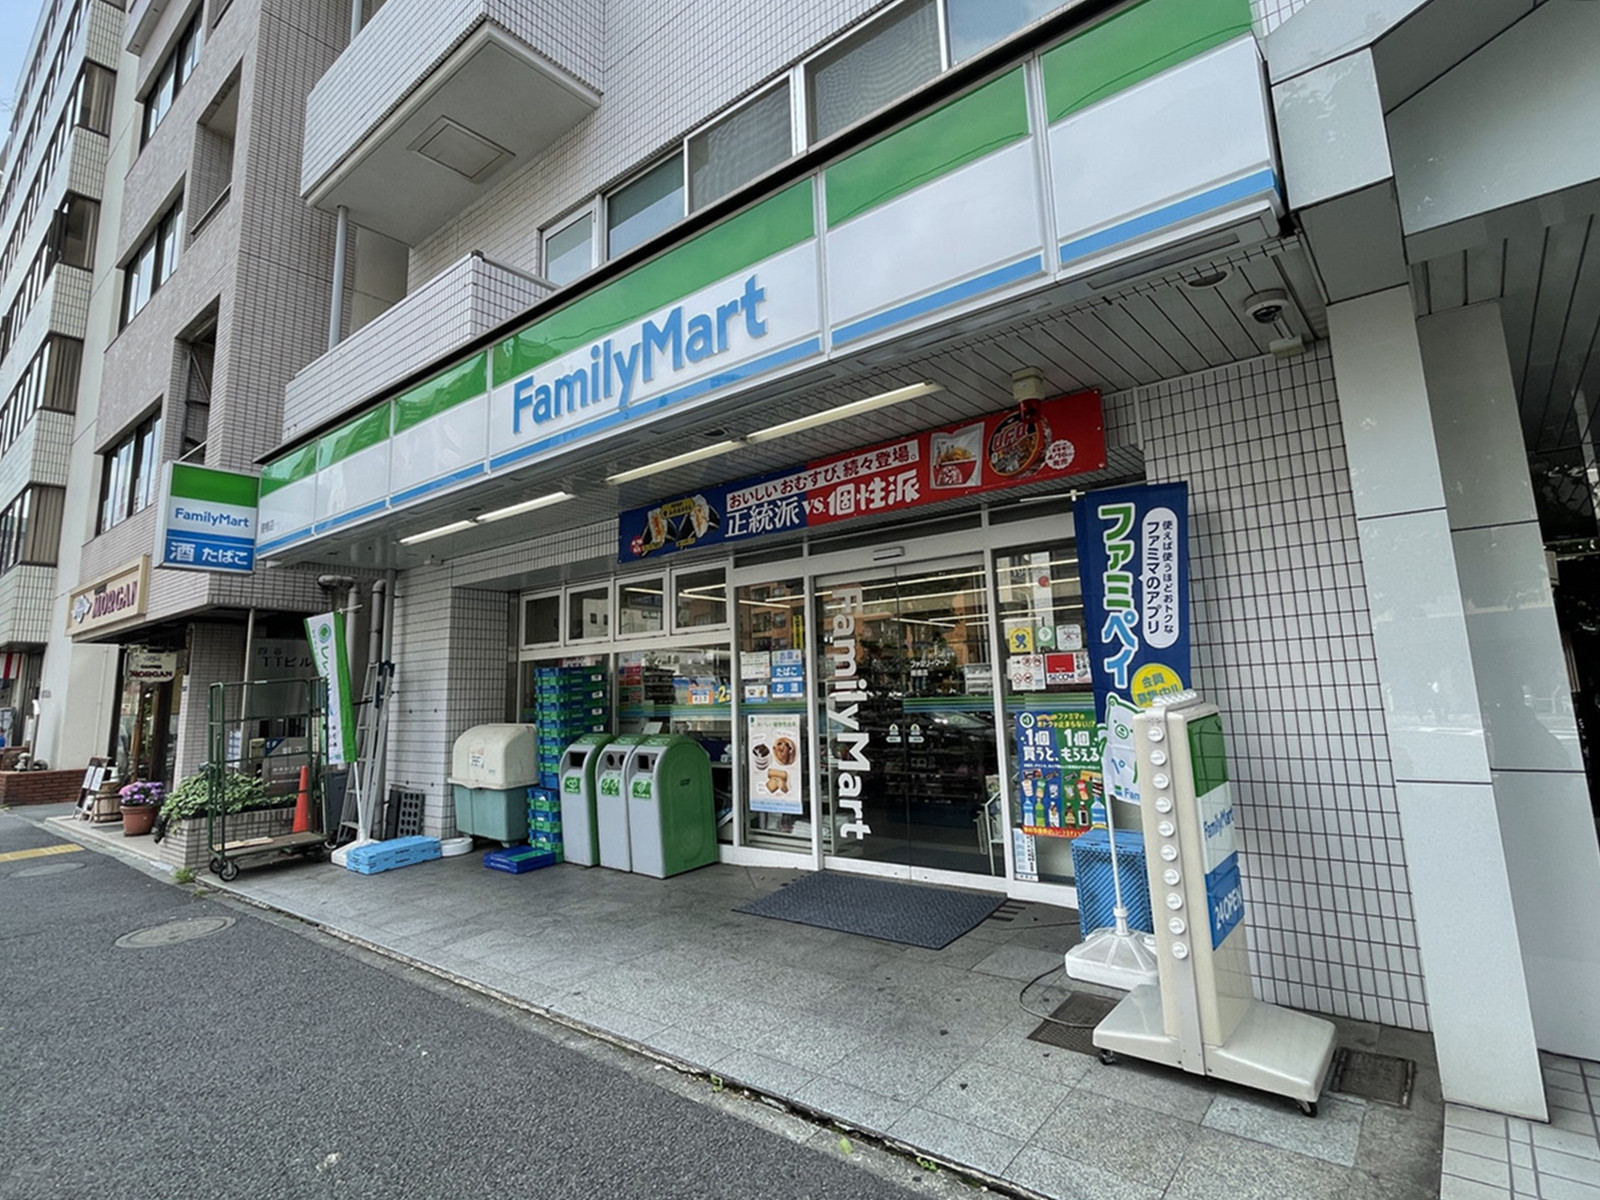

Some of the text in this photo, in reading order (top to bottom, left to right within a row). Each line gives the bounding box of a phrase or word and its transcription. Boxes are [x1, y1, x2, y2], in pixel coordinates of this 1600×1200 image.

[512, 274, 768, 435] FamilyMart
[724, 496, 801, 538] 正統派
[827, 469, 920, 516] 個性派
[174, 507, 250, 528] FamilyMart
[169, 542, 249, 566] 酒 たばこ
[1147, 521, 1162, 634] ファミマのアプリ
[1163, 520, 1174, 634] 使えば使うほどおトクな
[1098, 503, 1140, 689] ファミペイ
[262, 656, 312, 667] TTビル
[776, 667, 798, 677] たばこ
[828, 588, 872, 841] FamilyMart
[1025, 729, 1050, 746] 1個
[1064, 729, 1090, 747] 1個
[1023, 747, 1059, 761] 買うと、
[1061, 747, 1100, 762] もらえる
